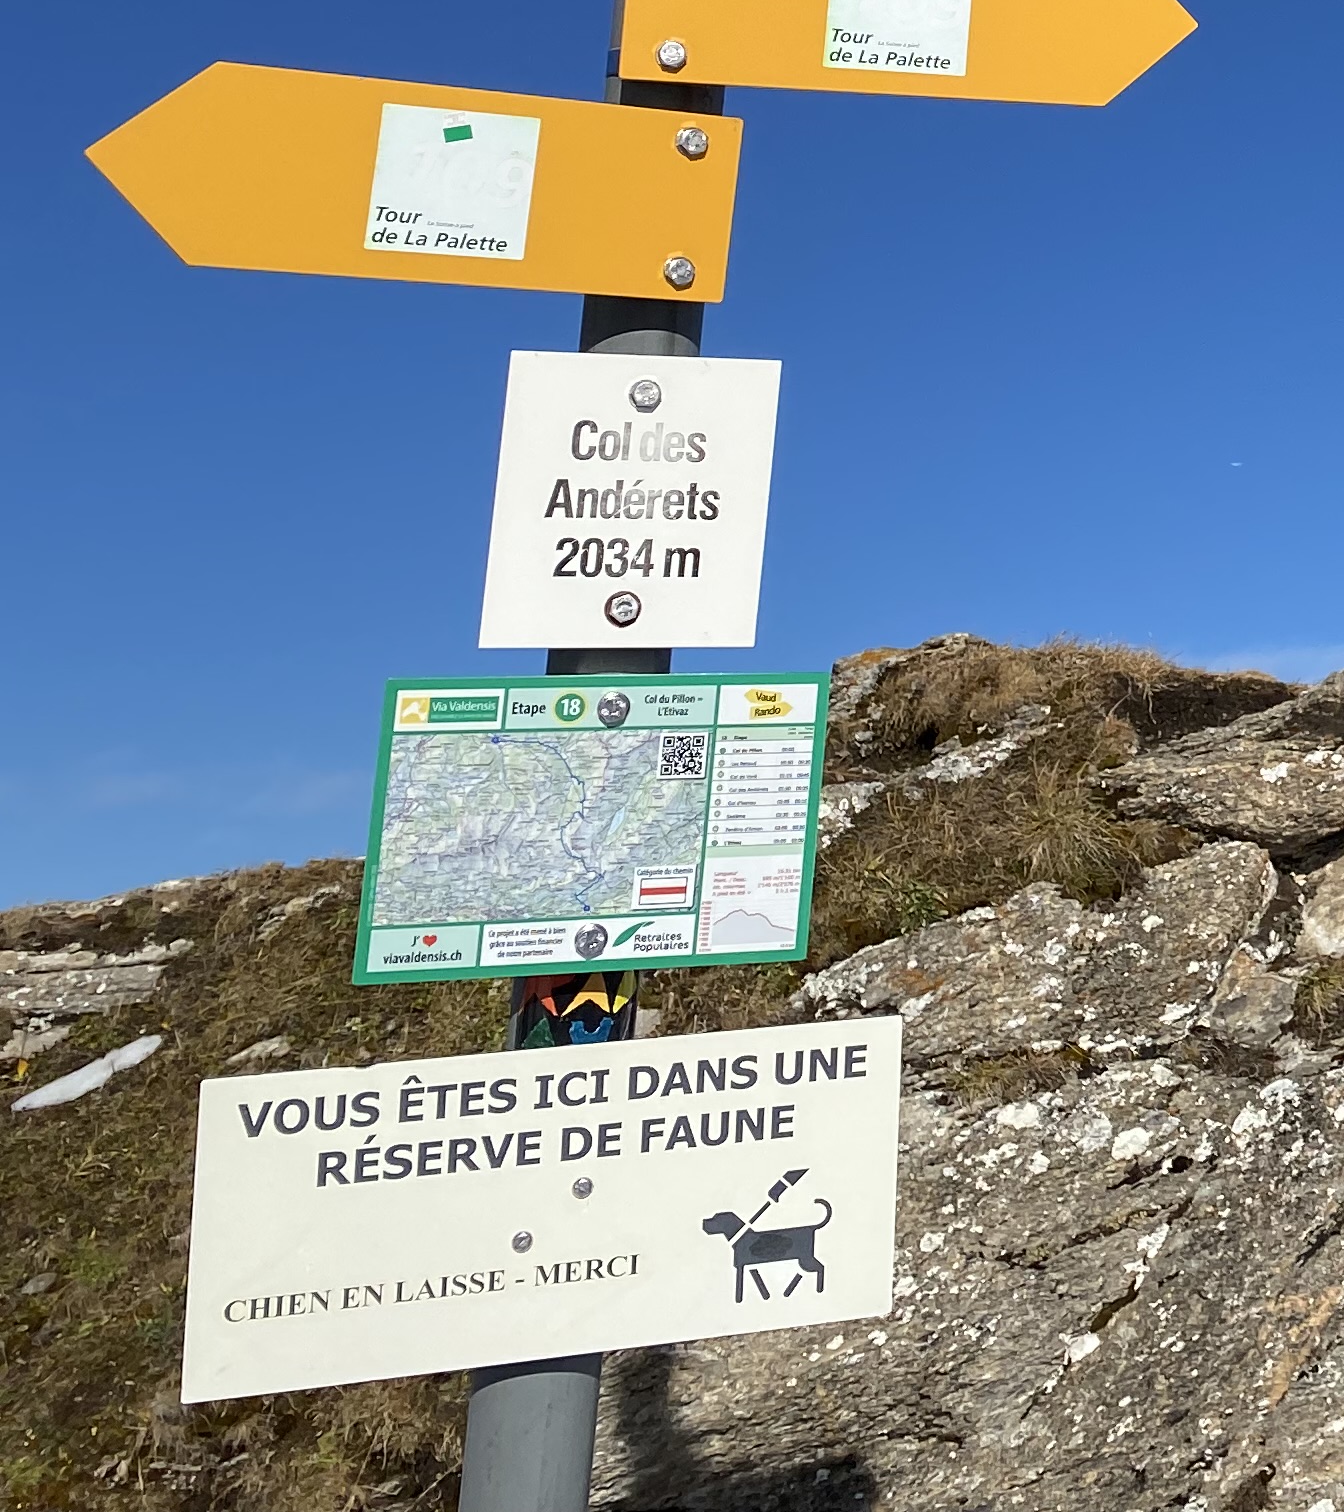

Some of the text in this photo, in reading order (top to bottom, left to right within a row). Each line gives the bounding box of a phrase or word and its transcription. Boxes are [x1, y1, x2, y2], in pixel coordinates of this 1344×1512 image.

[832, 28, 874, 45] Tour
[829, 47, 951, 70] de La Palette
[375, 206, 422, 225] Tour
[371, 227, 508, 253] de La Palette
[571, 419, 707, 463] Col des
[543, 478, 721, 520] Andérets
[552, 537, 700, 578] 2034 m
[432, 700, 496, 712] Via Valdensis
[644, 694, 657, 704] Col
[659, 694, 670, 703] du
[756, 691, 777, 702] Vaud
[511, 698, 581, 718] Etape 18
[754, 705, 781, 717] Rando
[633, 940, 689, 953] Populaires
[634, 933, 682, 943] Retraites
[383, 949, 462, 965] viavaldensis.ch
[238, 1044, 867, 1138] VOUS ÊTES ICI DANS UNE
[316, 1104, 795, 1187] RÉSERVE DE FAUNE
[223, 1289, 331, 1323] CHIEN
[340, 1283, 384, 1310] EN
[394, 1269, 505, 1303] LAISSE
[534, 1253, 640, 1286] MERCI
